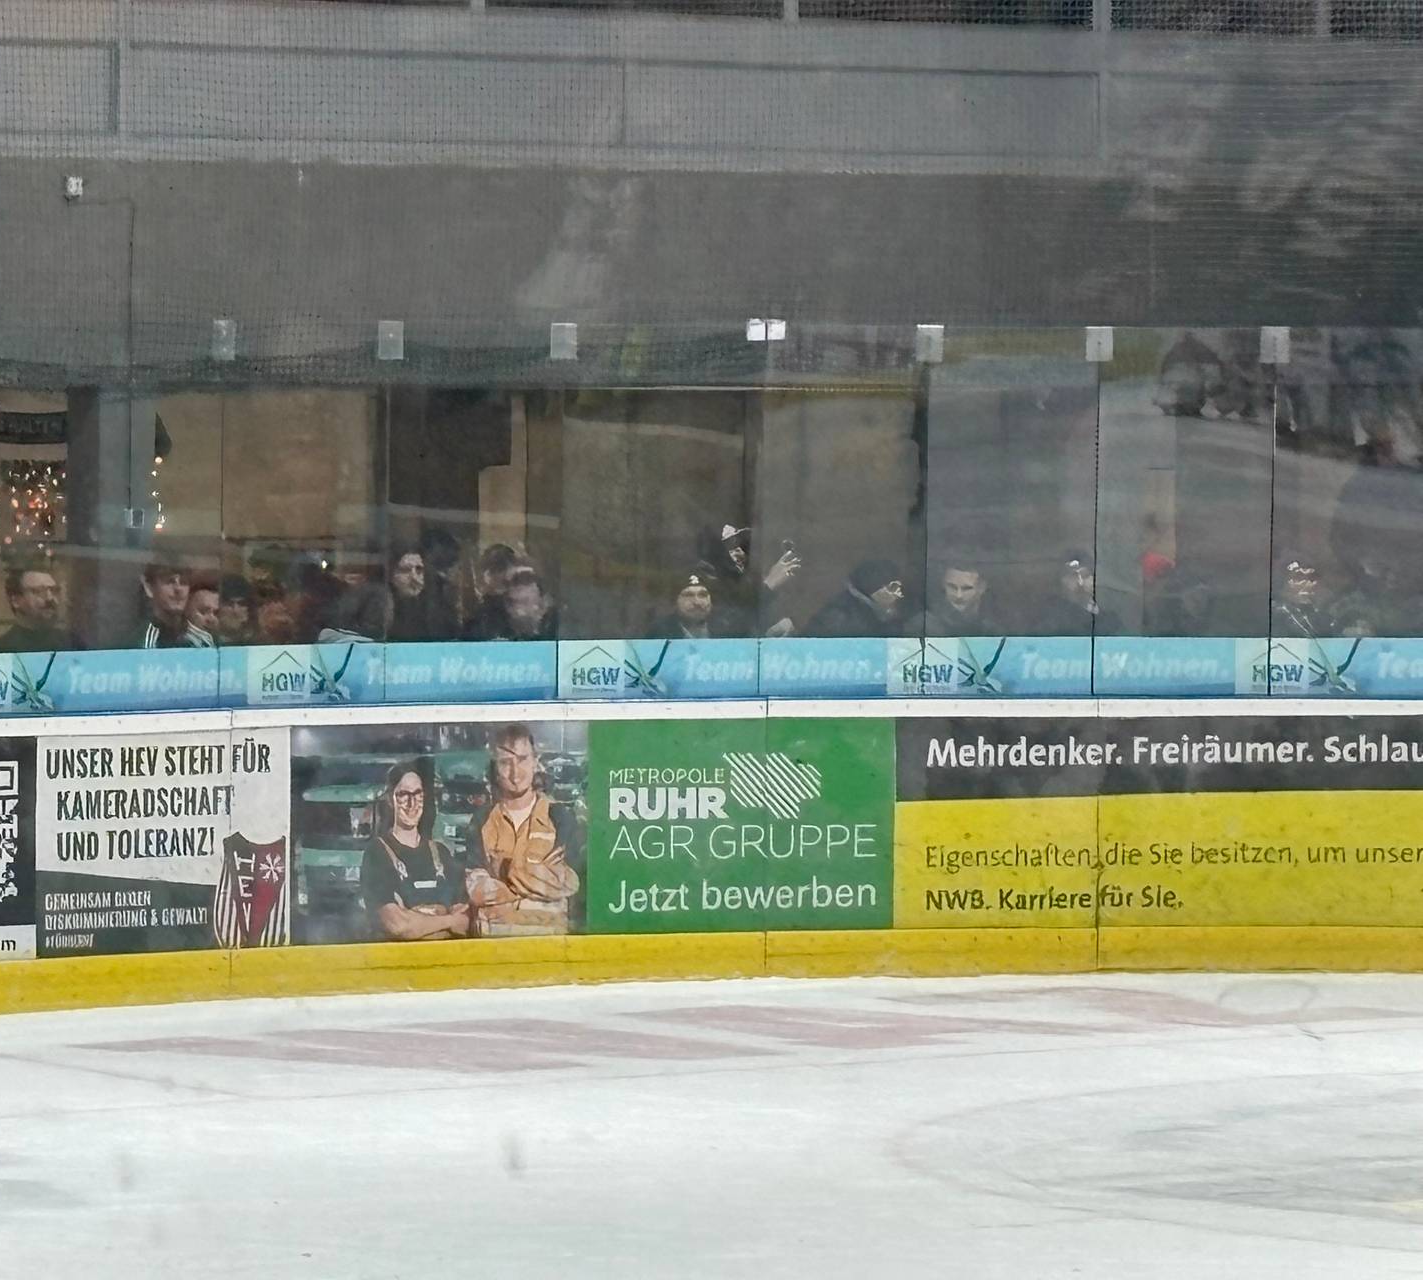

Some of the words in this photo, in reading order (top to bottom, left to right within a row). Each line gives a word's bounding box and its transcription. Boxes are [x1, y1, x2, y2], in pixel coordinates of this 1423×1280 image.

[68, 664, 132, 695] Team
[571, 666, 624, 686] HGW
[684, 652, 755, 683] Team
[903, 663, 953, 684] HGW
[1252, 664, 1304, 683] HGW
[1377, 652, 1423, 680] Tea
[262, 672, 306, 692] HGW
[45, 746, 114, 780] UNSER
[120, 745, 158, 778] HEV
[164, 743, 225, 776] STEHT
[232, 737, 271, 774] FÜR
[927, 735, 1122, 767] Mehrdenker.
[1133, 733, 1315, 764] Freiräumer.
[609, 767, 726, 785] METROPOLE
[56, 785, 234, 822] KAMERADSCHAFT
[609, 786, 729, 821] RUHR
[56, 829, 100, 862] UND
[107, 825, 215, 861] TOLERANZ!
[609, 825, 698, 860] AGR
[709, 823, 878, 860] GRUPPE
[926, 842, 1104, 875] Eigenschaften,
[1105, 842, 1143, 867] die
[1150, 841, 1184, 866] Sie
[1192, 841, 1300, 868] besitzen,
[1308, 846, 1347, 864] um
[45, 889, 111, 912] GEMEINSAM
[609, 879, 690, 914] Jetzt
[702, 875, 878, 911] bewerben
[1000, 885, 1093, 912] Karriere
[1099, 884, 1133, 908] für
[1142, 885, 1184, 910] Sie.
